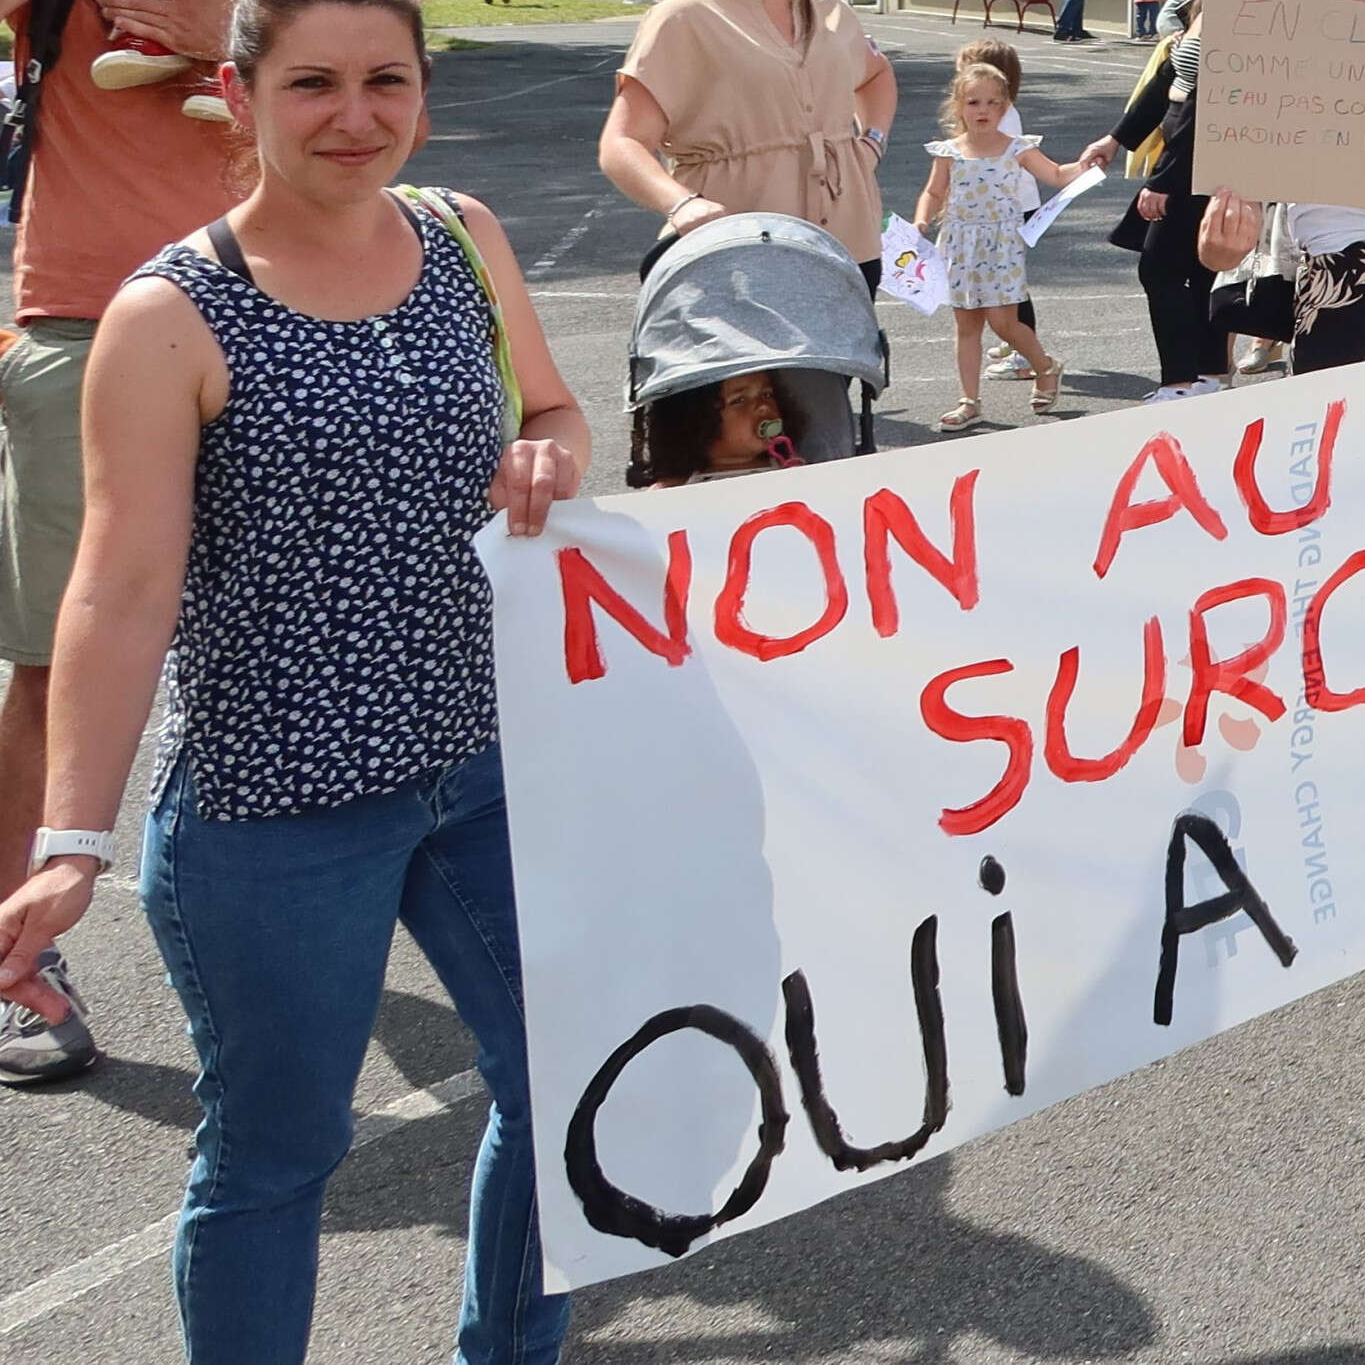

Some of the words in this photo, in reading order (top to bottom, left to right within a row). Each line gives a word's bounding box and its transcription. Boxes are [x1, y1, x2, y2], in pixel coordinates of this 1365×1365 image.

[1232, 0, 1301, 41] EN
[1205, 49, 1312, 80] COMME
[1329, 60, 1365, 82] UN
[1207, 87, 1268, 106] L'EAU
[1207, 123, 1307, 147] SARDINE
[557, 469, 981, 682] NON
[1154, 813, 1297, 1026] A
